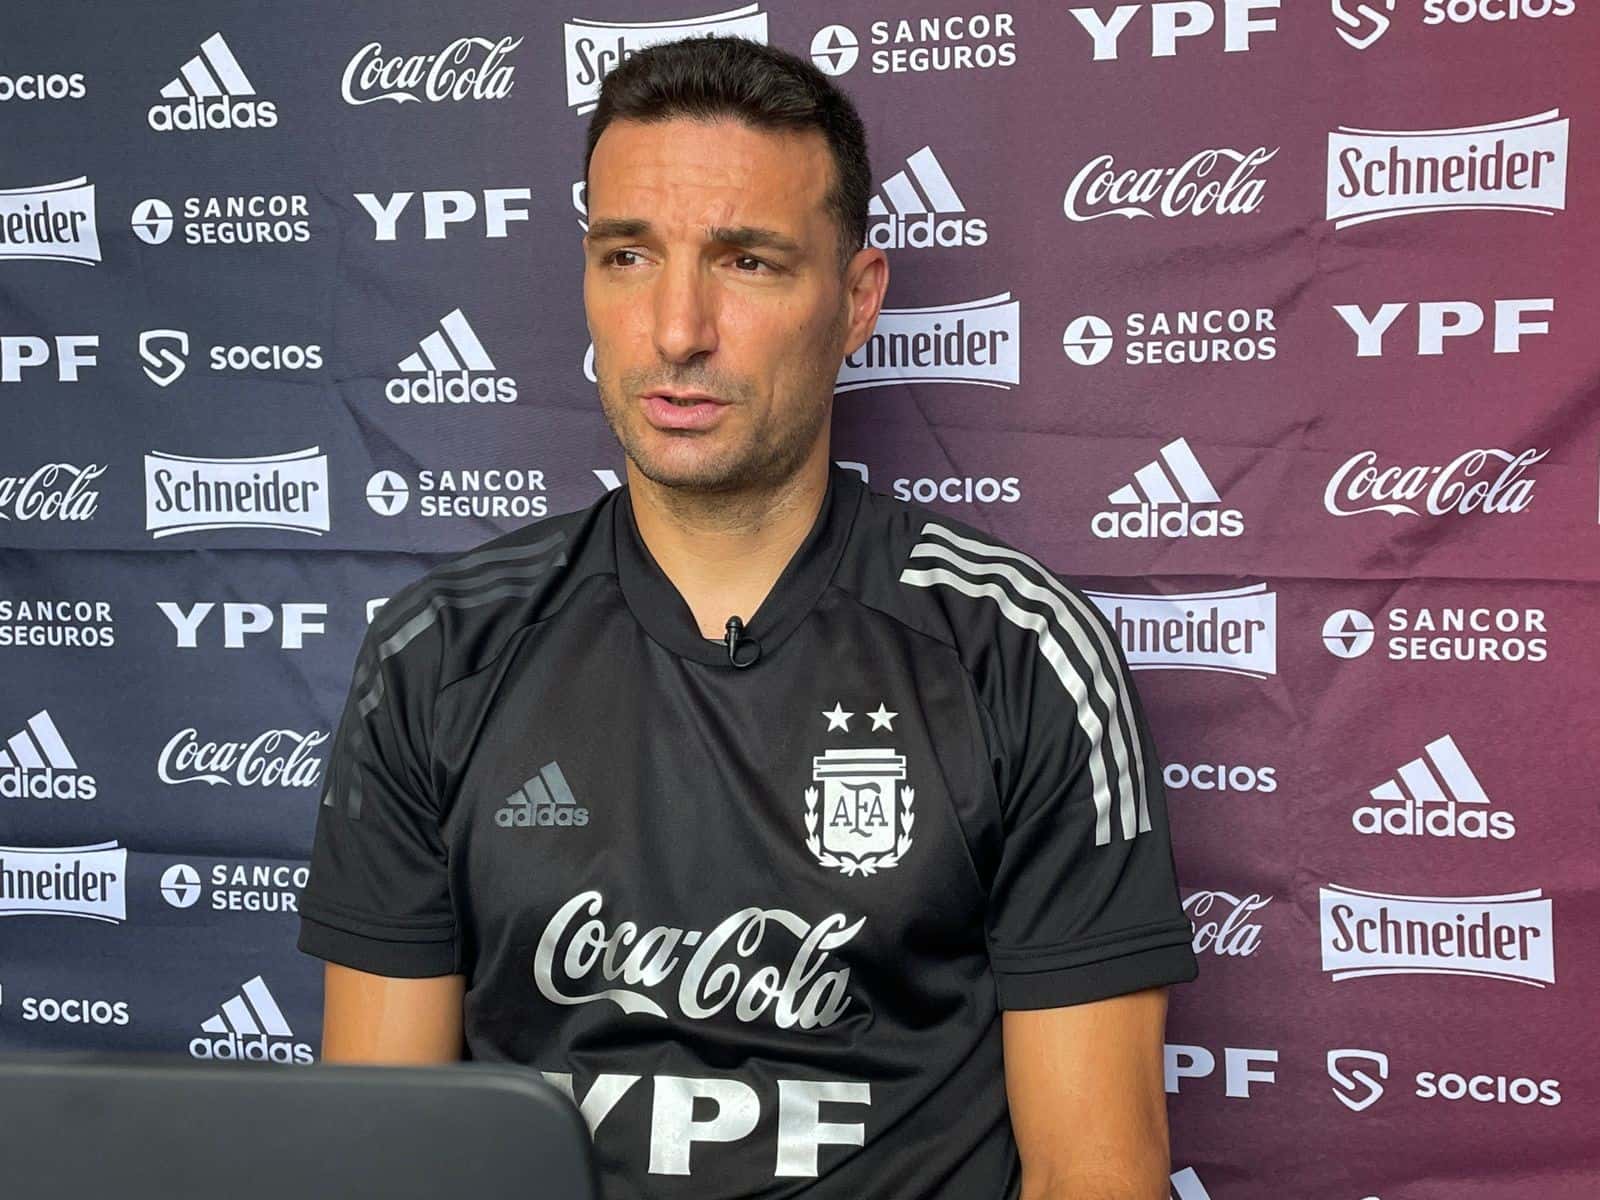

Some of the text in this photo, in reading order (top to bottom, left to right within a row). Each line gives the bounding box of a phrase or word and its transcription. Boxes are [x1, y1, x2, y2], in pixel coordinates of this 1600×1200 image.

[1424, 0, 1575, 24] SOCIOS
[872, 14, 1015, 45] SANCOR
[1069, 0, 1280, 60] YPF
[342, 37, 523, 104] Coca-Cola
[872, 43, 1016, 74] SEGUROS
[0, 74, 85, 100] OCIOS
[148, 97, 277, 131] adidas
[1064, 147, 1280, 221] Coca-Cola
[1338, 140, 1555, 197] Schneider
[0, 200, 87, 244] eider
[184, 196, 308, 218] SANCOR
[354, 189, 531, 240] YPF
[185, 221, 310, 244] SEGUROS
[864, 212, 987, 249] didas
[1127, 308, 1276, 337] SANCOR
[1333, 299, 1553, 356] YPF
[0, 336, 99, 381] PF
[211, 345, 322, 369] SOCIOS
[1127, 338, 1277, 364] SEGUROS
[386, 371, 517, 403] adidas
[0, 464, 107, 520] a-Cola
[155, 469, 319, 512] Schneider
[419, 470, 546, 491] SANCOR
[894, 478, 1020, 502] SOCIOS
[1324, 449, 1549, 516] Coca-Cola
[421, 496, 547, 516] SEGUROS
[1092, 503, 1244, 538] adidas
[0, 601, 112, 621] SANCOR
[157, 603, 327, 648] YPF
[1389, 609, 1546, 632] SANCOR
[0, 626, 114, 646] SEGUROS
[1114, 606, 1265, 655] hneider
[1389, 637, 1547, 661] SEGUROS
[158, 728, 329, 787] Coca-Cola
[0, 767, 96, 800] didas
[1164, 764, 1277, 792] OCIOS
[495, 804, 588, 827] adidas
[830, 782, 888, 837] AFA
[1353, 801, 1515, 839] adidas
[0, 859, 116, 902] hneider
[212, 865, 309, 887] SANCO
[213, 890, 298, 911] SEGUR
[1331, 904, 1543, 961] Schneider
[535, 891, 866, 1028] Coca-Cola
[23, 998, 128, 1024] SOCIOS
[190, 1032, 313, 1064] adidas
[1164, 1045, 1278, 1097] PF
[1416, 1072, 1560, 1105] SOCIOS
